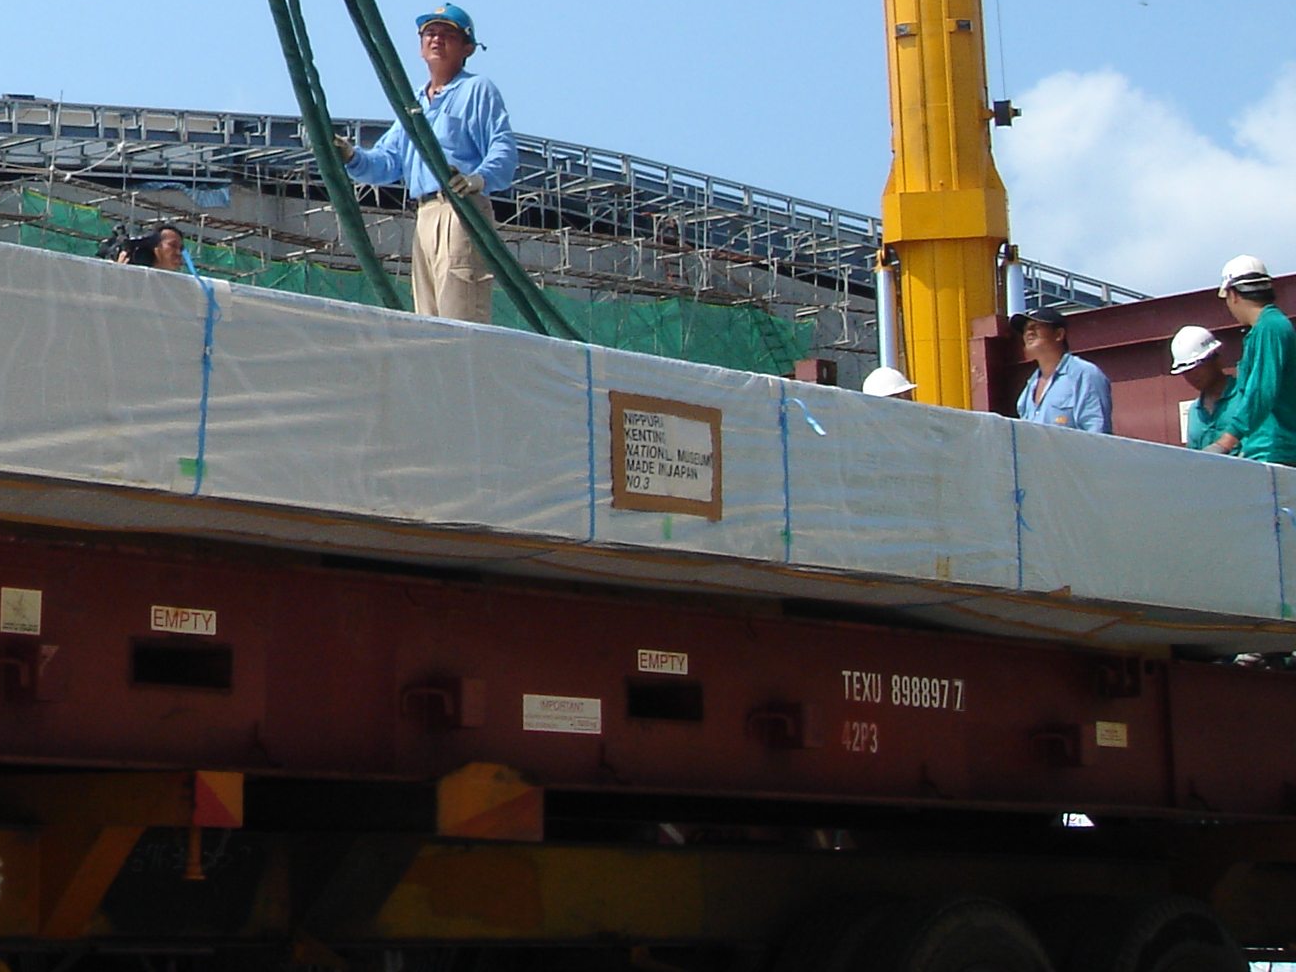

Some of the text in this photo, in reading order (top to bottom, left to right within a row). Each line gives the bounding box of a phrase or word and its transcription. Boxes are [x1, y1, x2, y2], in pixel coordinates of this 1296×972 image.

[626, 458, 655, 475] MADE
[666, 464, 698, 481] JAPAN
[153, 608, 213, 631] EMPTY
[639, 651, 686, 672] EMPTY
[842, 670, 882, 704] TEXU
[539, 700, 585, 713] IMPORTANT
[841, 720, 879, 754] 42P3
